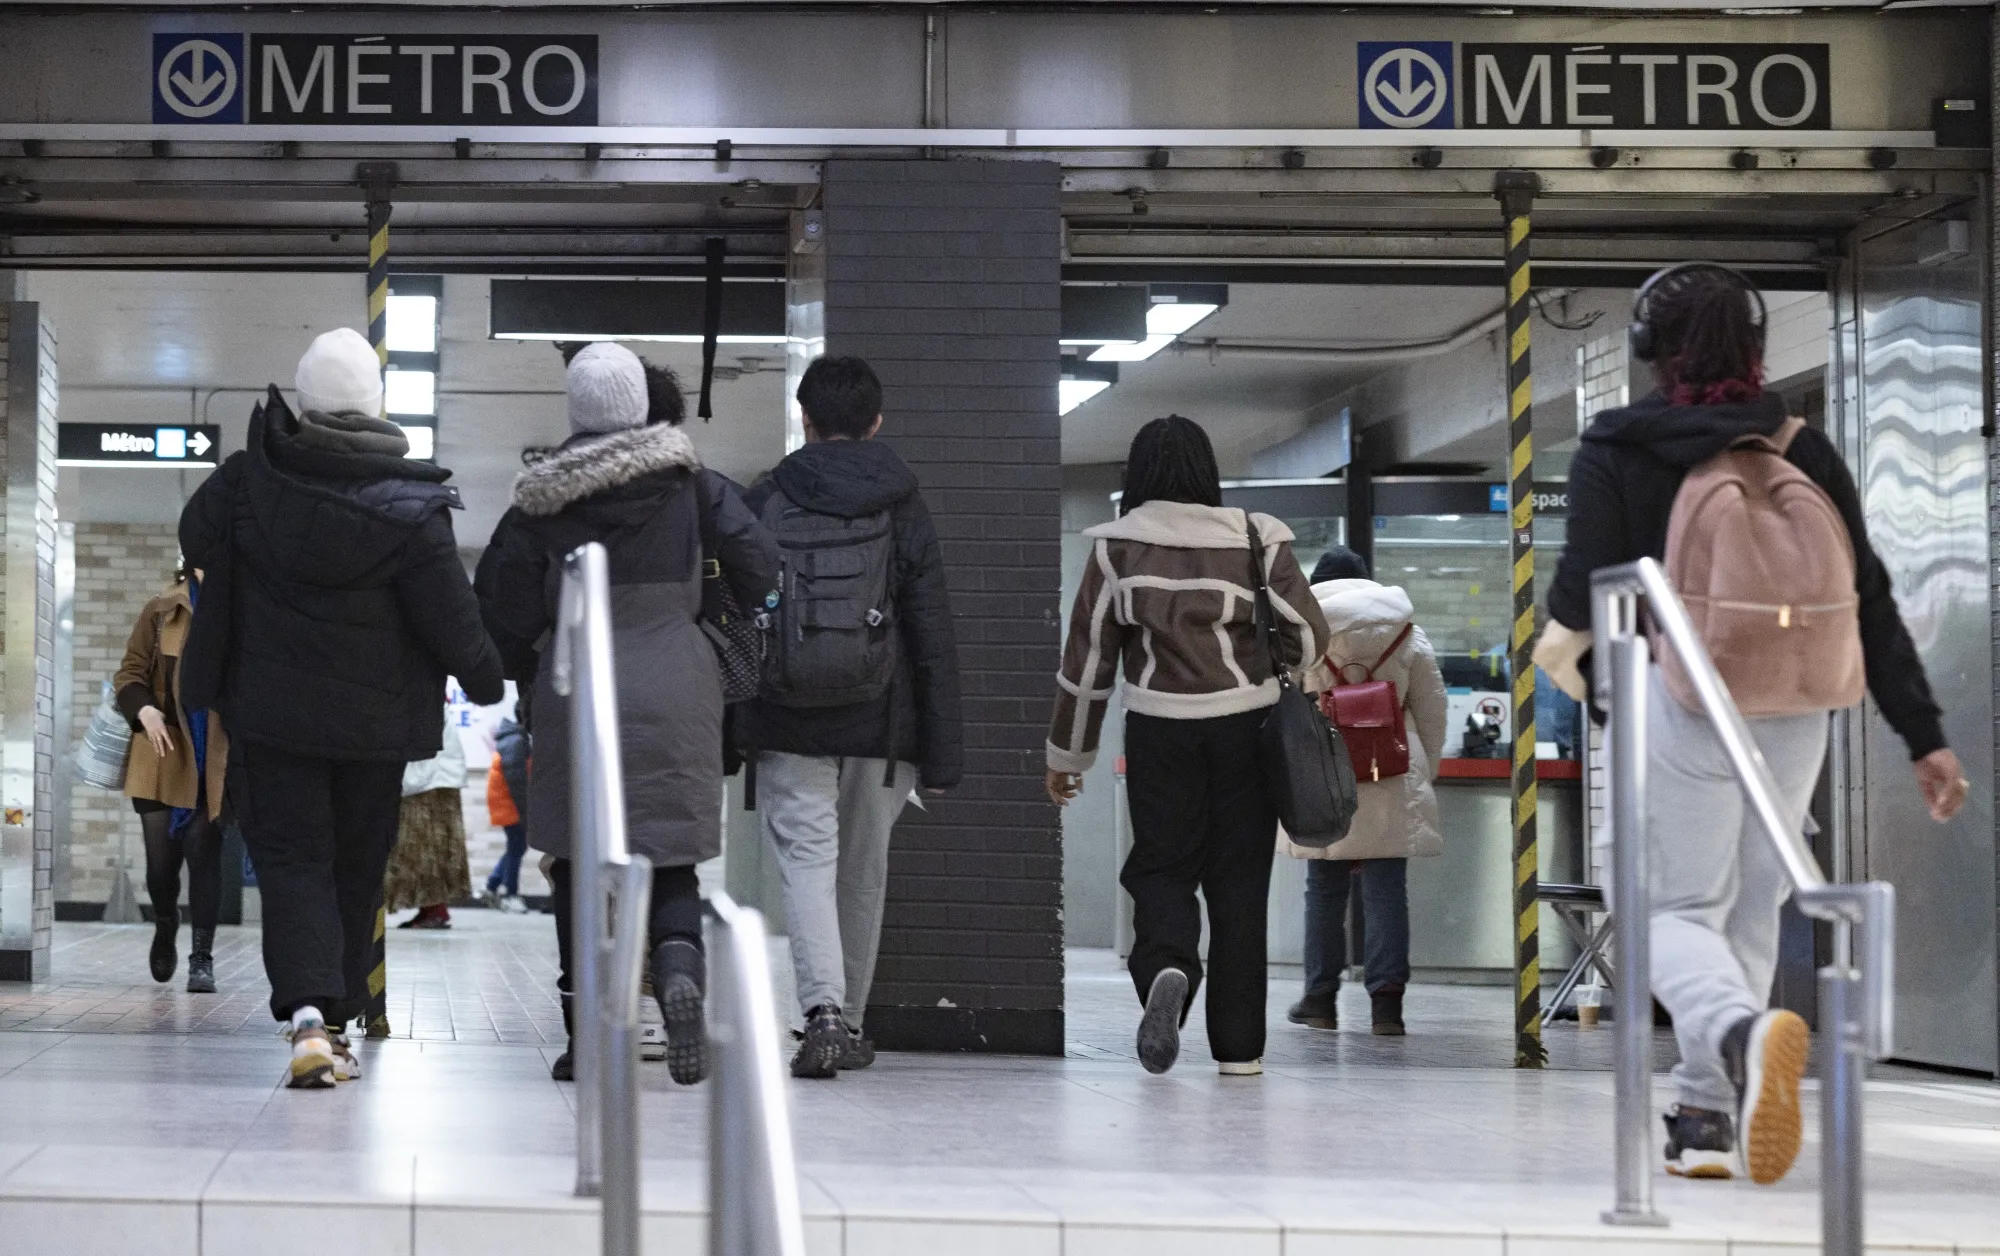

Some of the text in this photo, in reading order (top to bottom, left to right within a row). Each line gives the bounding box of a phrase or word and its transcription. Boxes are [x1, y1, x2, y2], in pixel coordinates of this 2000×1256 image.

[261, 36, 587, 116] MÉTRO
[1474, 45, 1818, 127] MÉTRO
[101, 432, 155, 453] Métro
[1532, 493, 1568, 511] spac
